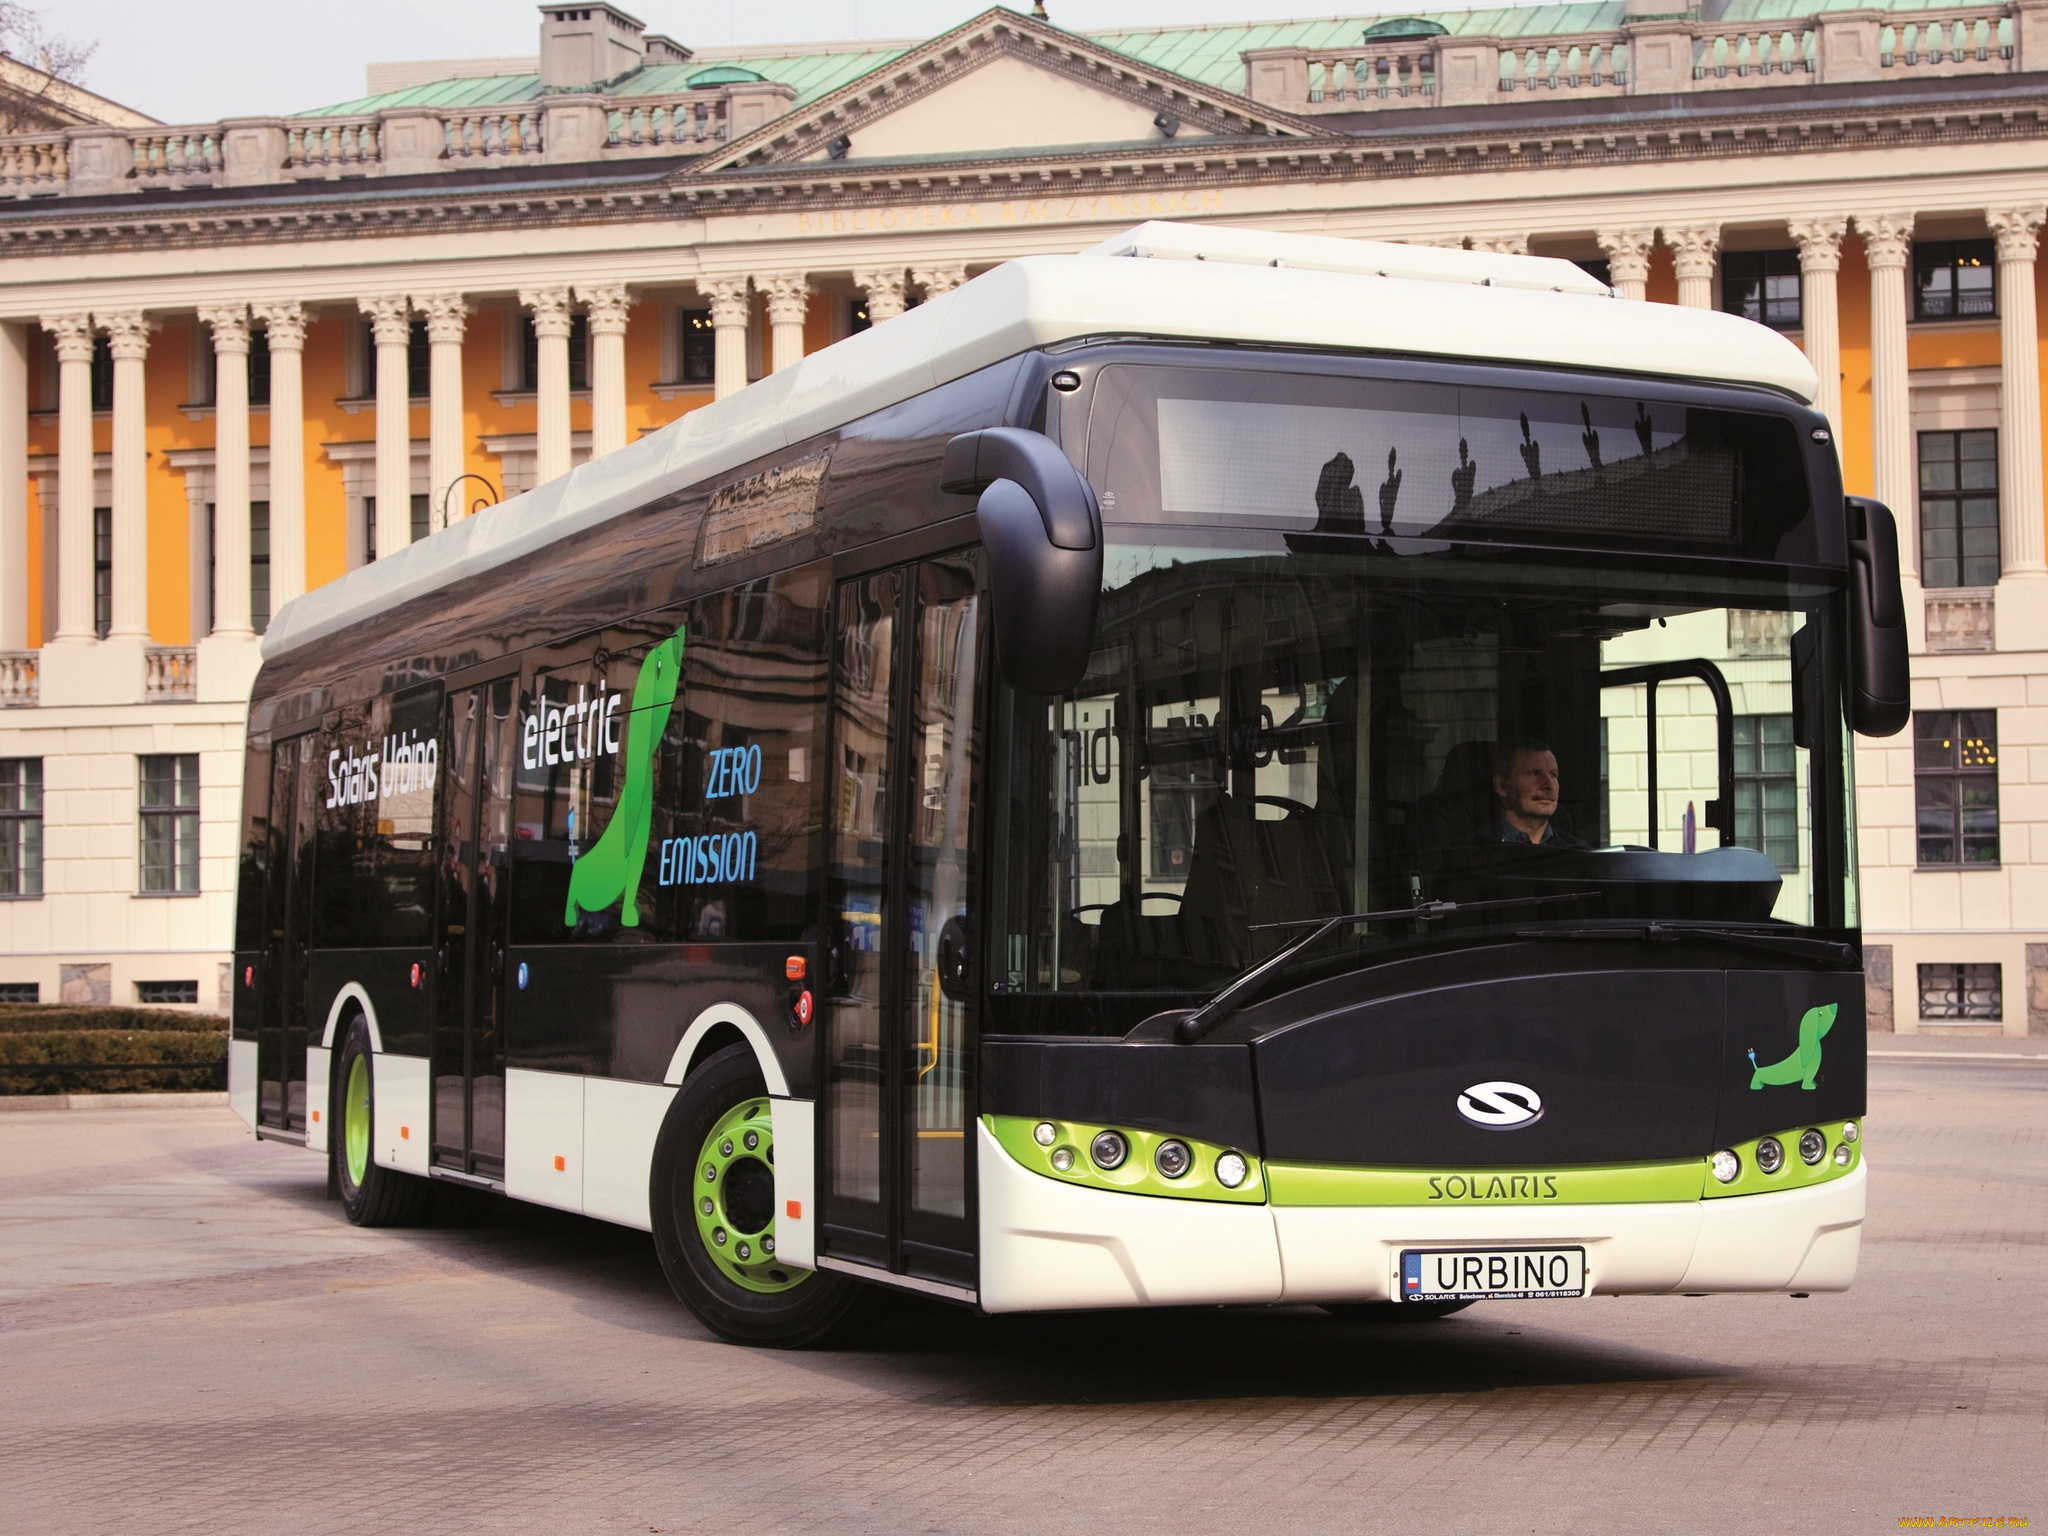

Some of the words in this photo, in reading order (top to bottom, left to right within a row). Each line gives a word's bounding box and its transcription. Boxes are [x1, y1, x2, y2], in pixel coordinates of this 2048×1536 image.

[799, 203, 981, 233] BIBLIOTEKA
[523, 679, 621, 770] electric
[326, 735, 379, 809] Solaris
[382, 729, 438, 798] Urbino
[706, 744, 762, 799] ZERO
[659, 831, 757, 886] EMISSION
[1428, 1175, 1558, 1199] SOLARIS
[1437, 1255, 1568, 1289] URBINO
